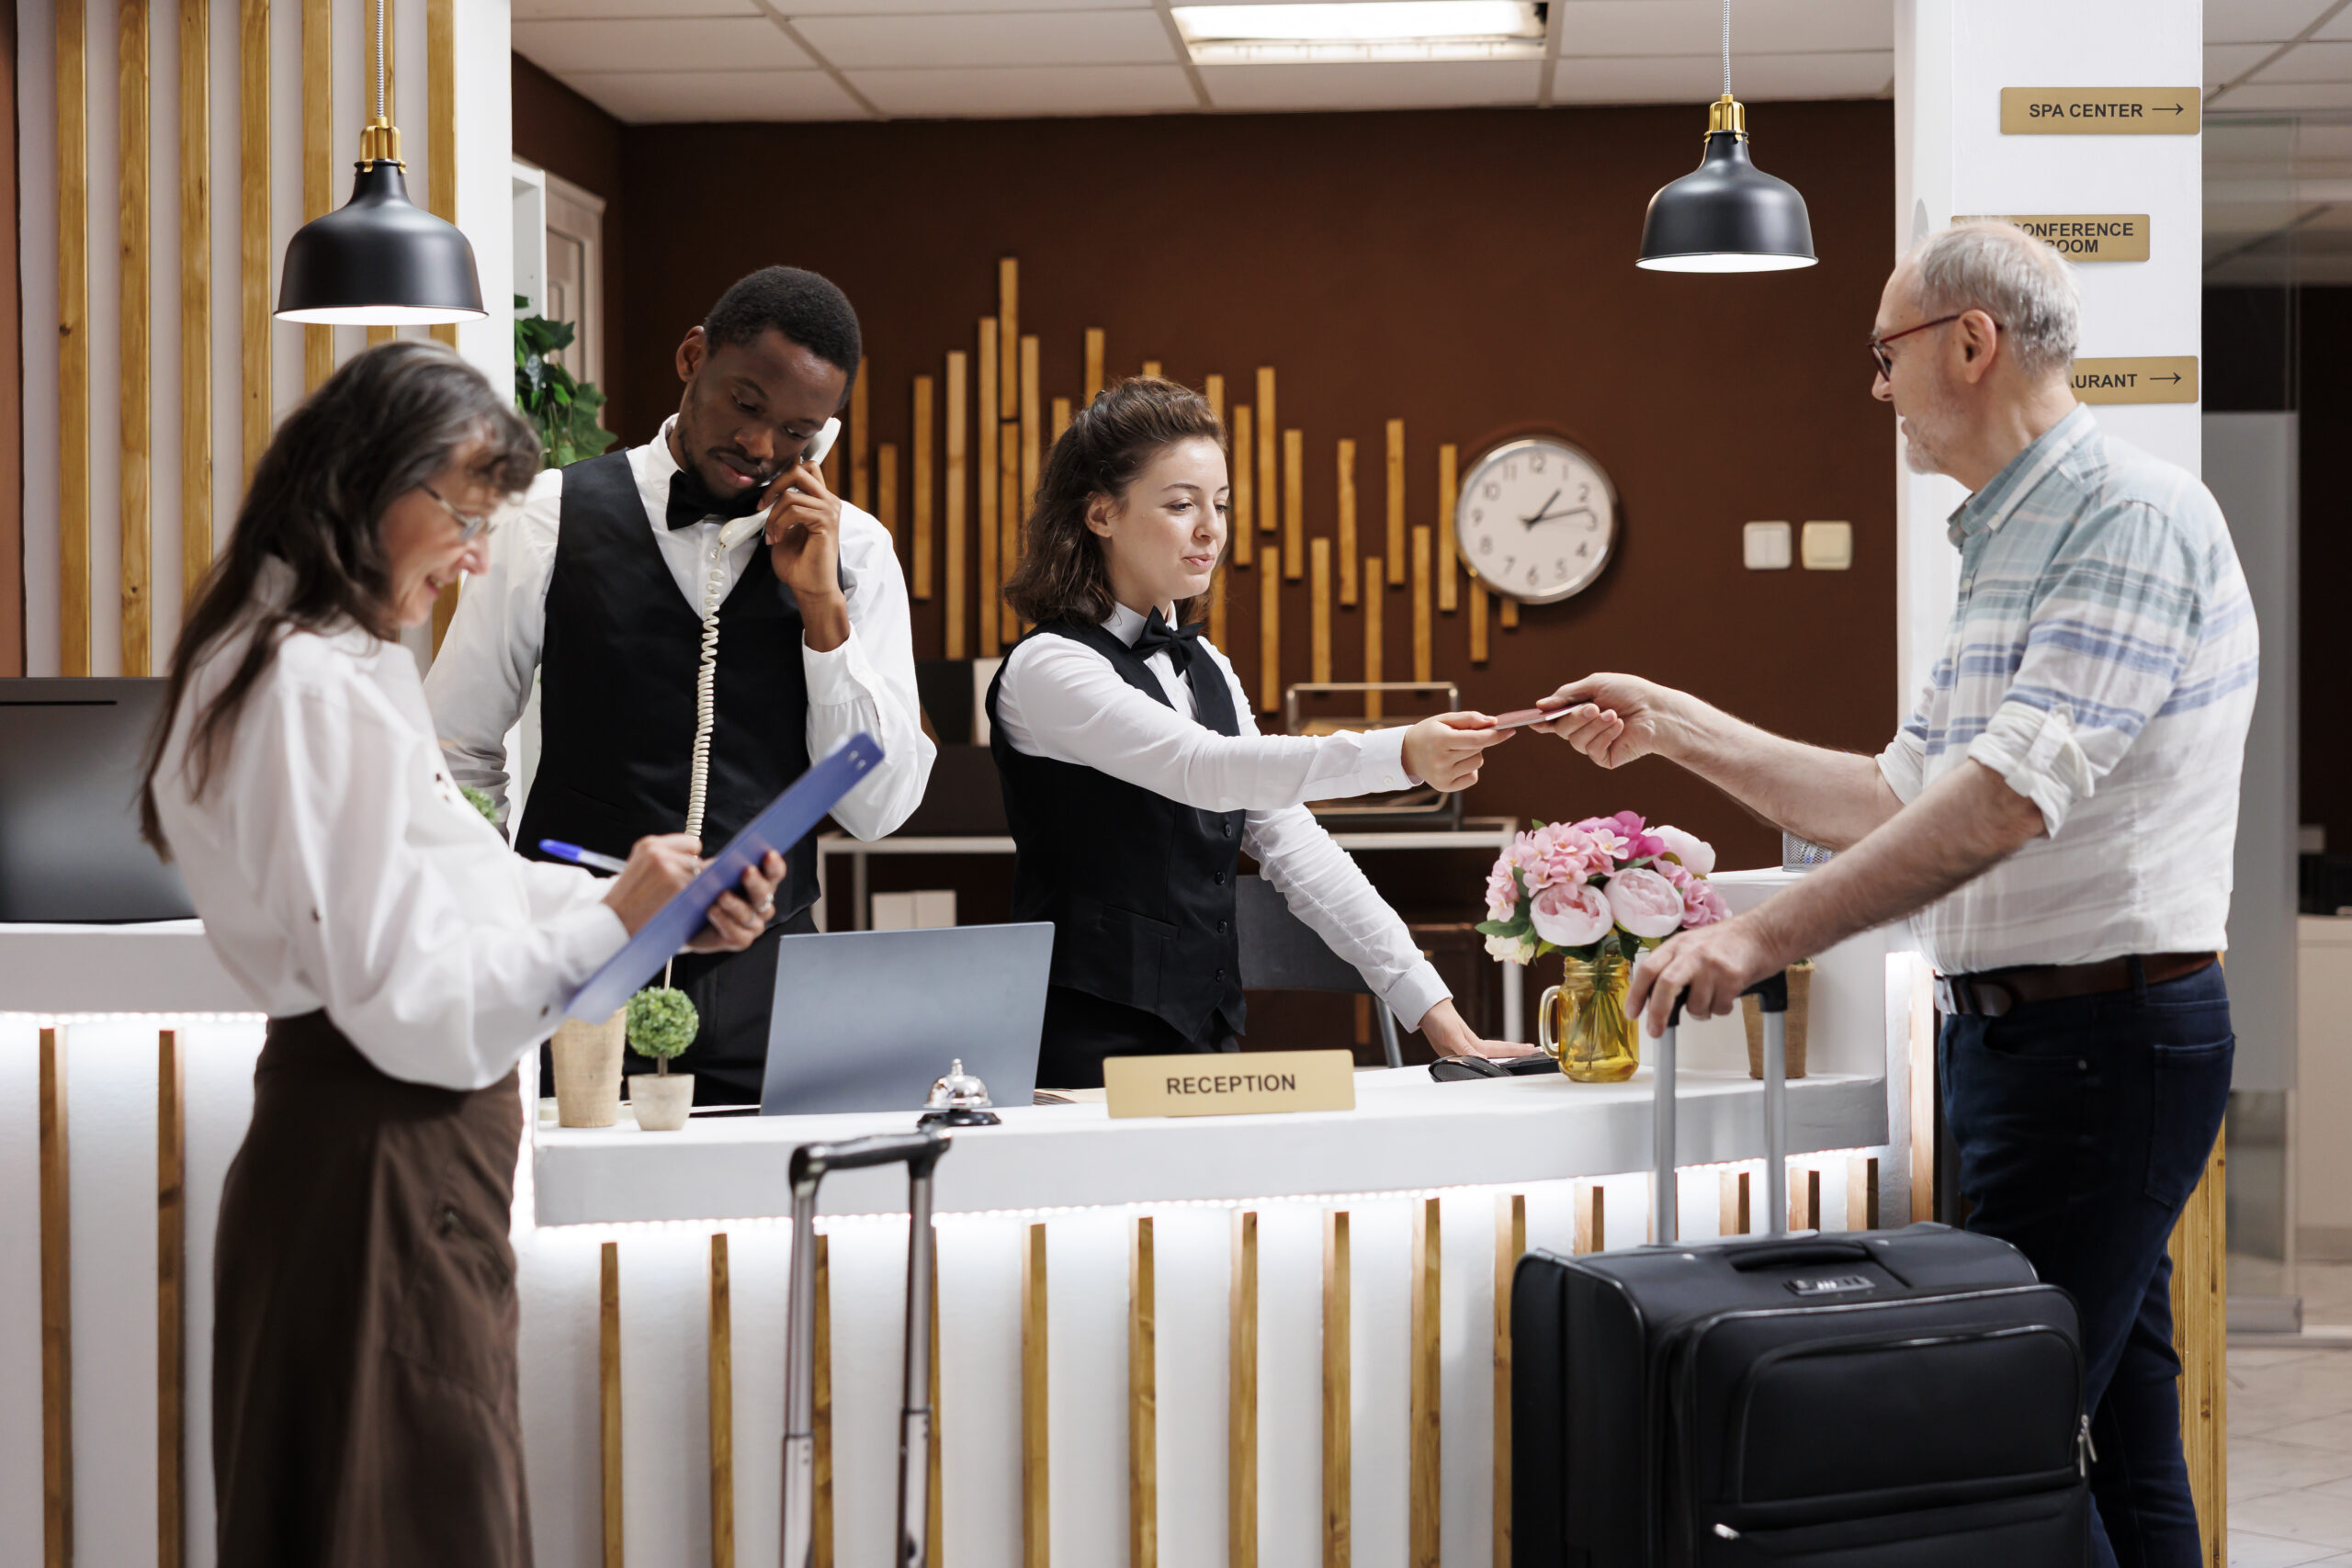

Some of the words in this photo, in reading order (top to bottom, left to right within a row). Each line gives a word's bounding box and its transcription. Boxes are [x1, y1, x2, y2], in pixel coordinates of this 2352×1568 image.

[2029, 104, 2064, 118] SPA
[2069, 104, 2143, 118] CENTER
[2014, 222, 2133, 237] ONFERENCE
[1529, 453, 1545, 474] 12
[1577, 482, 1590, 502] 2
[1166, 1074, 1296, 1095] RECEPTION
